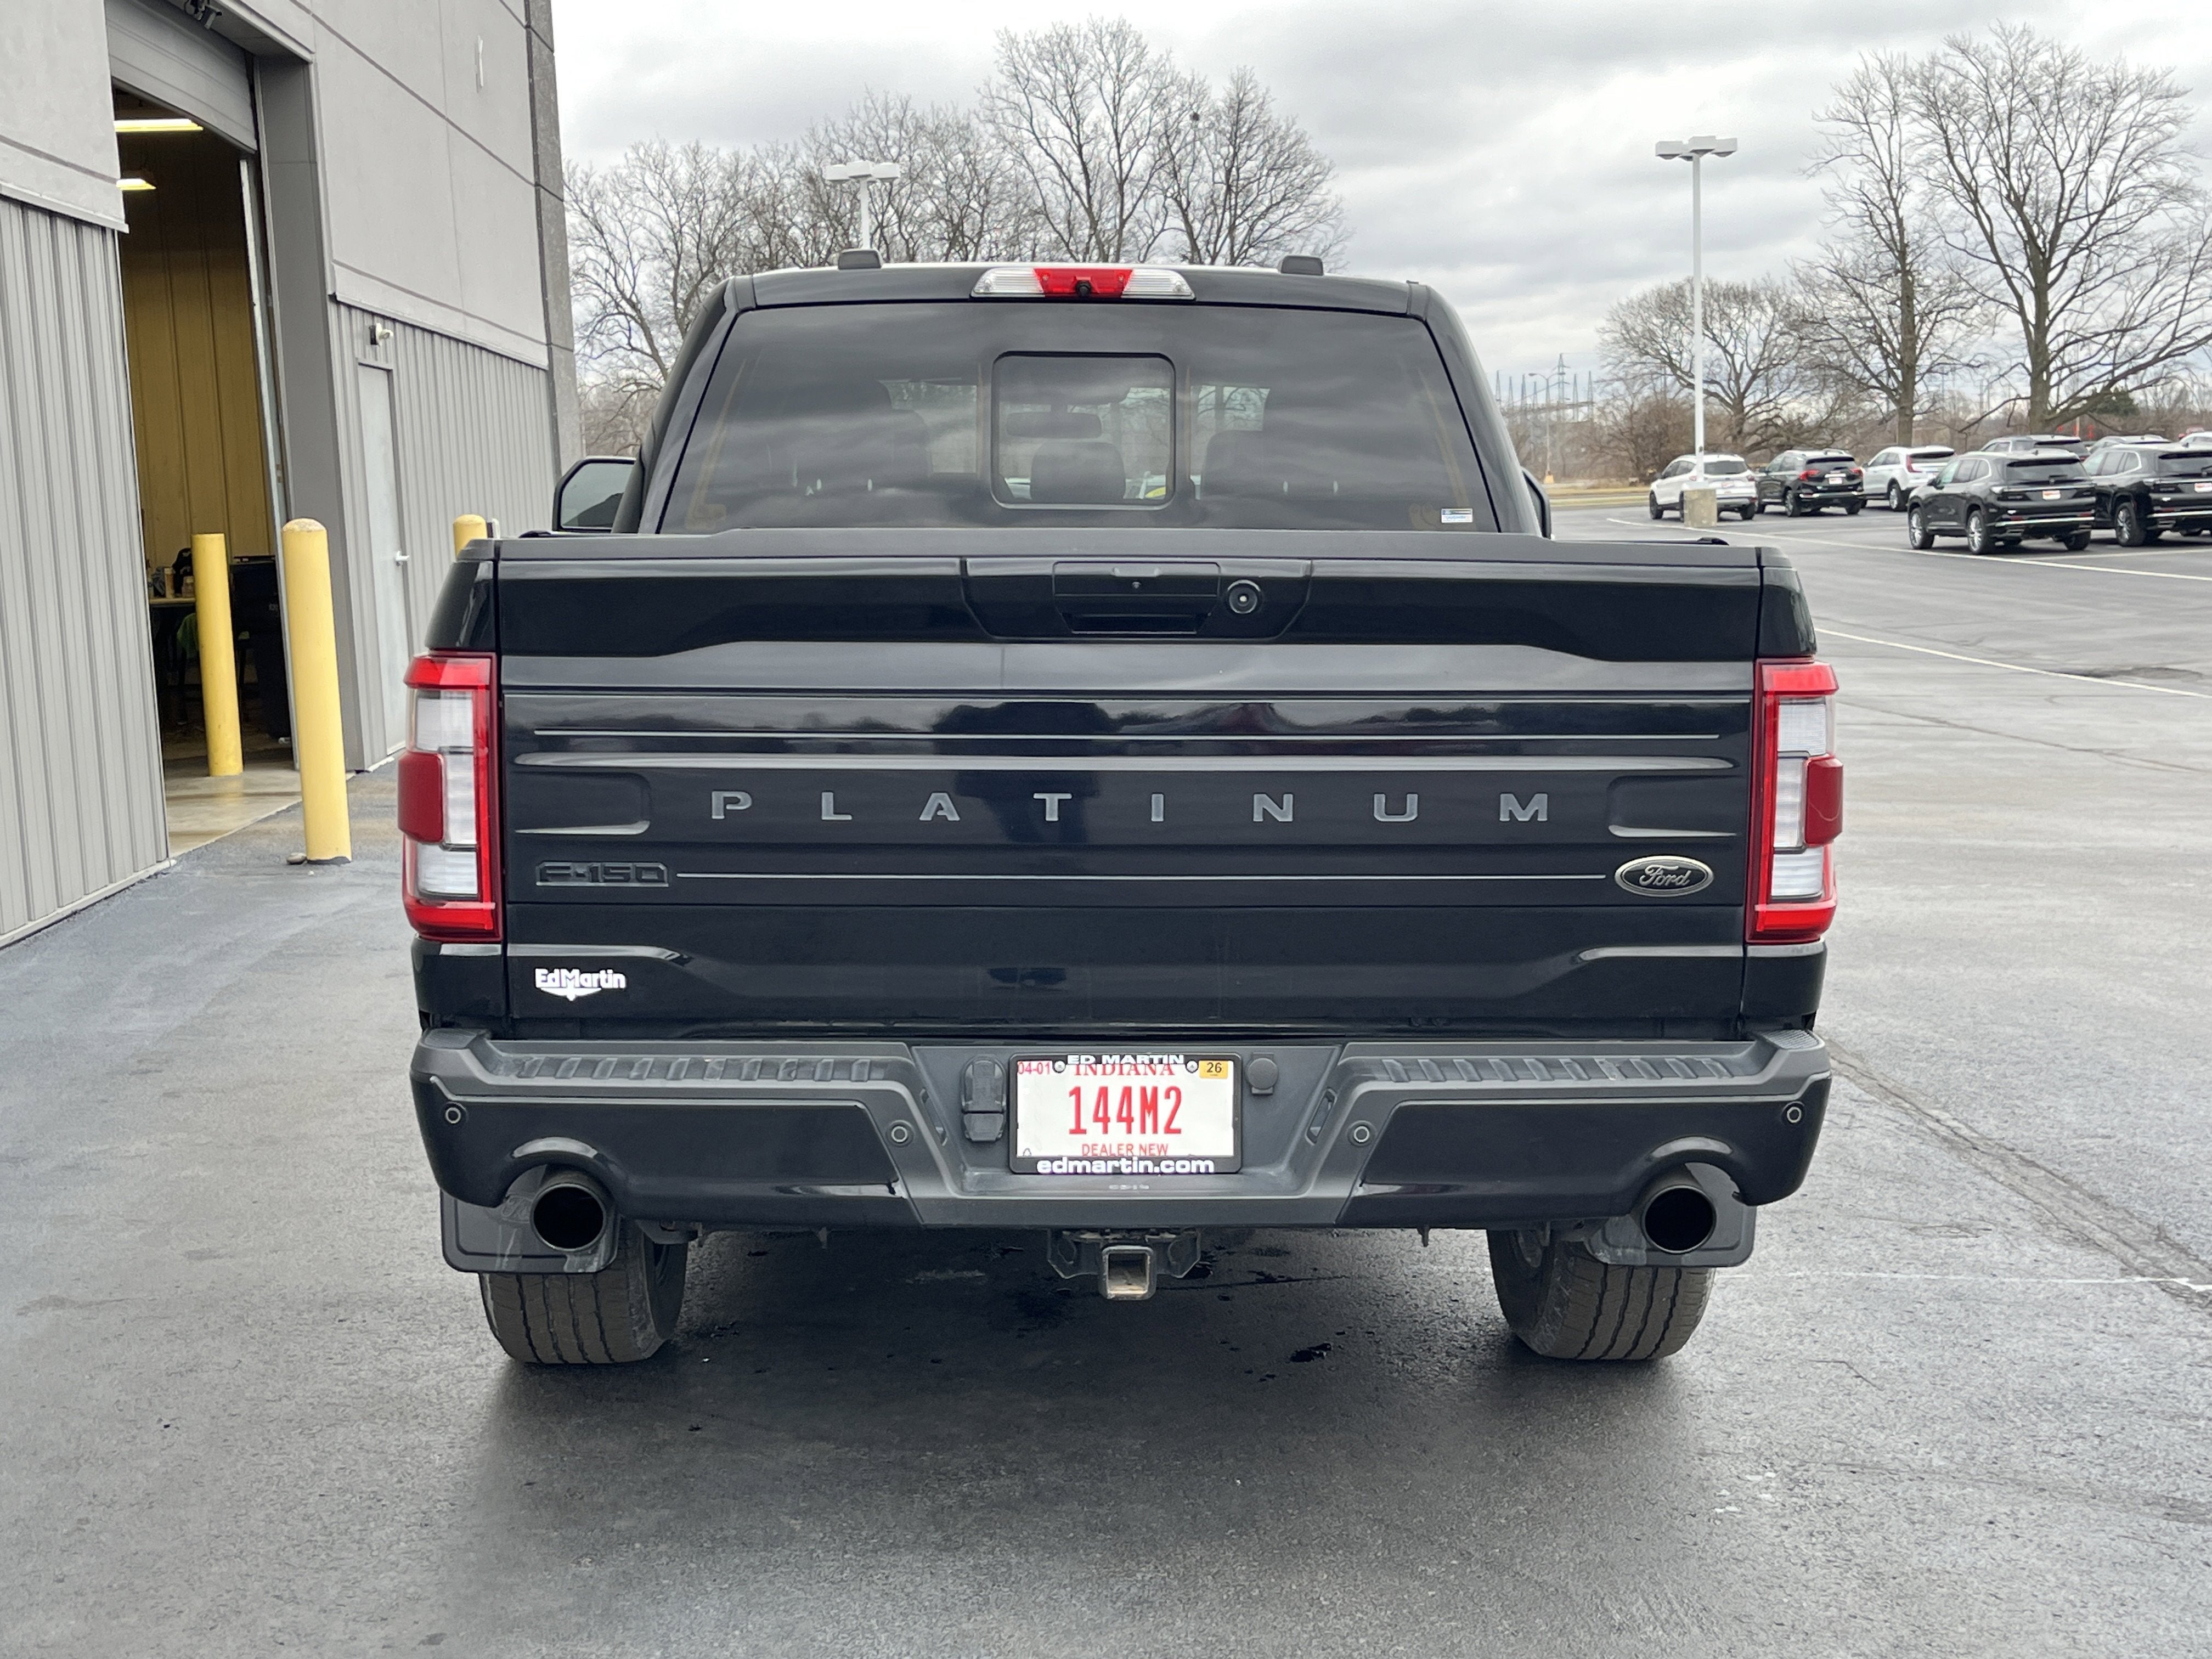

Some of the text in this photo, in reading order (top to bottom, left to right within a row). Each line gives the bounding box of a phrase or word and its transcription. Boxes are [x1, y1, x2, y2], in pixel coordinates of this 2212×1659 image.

[711, 791, 1548, 822] PLATINUM
[535, 862, 669, 887] F-150
[1639, 864, 1691, 886] Ford
[1068, 1054, 1184, 1065] ED MARTIN
[1017, 1062, 1051, 1075] 04-01
[1074, 1063, 1175, 1076] INDIANA
[1206, 1062, 1222, 1073] 26
[1068, 1085, 1182, 1135] 144M2
[1081, 1143, 1169, 1157] DEALER NEW
[1036, 1156, 1215, 1173] edmartin.com
